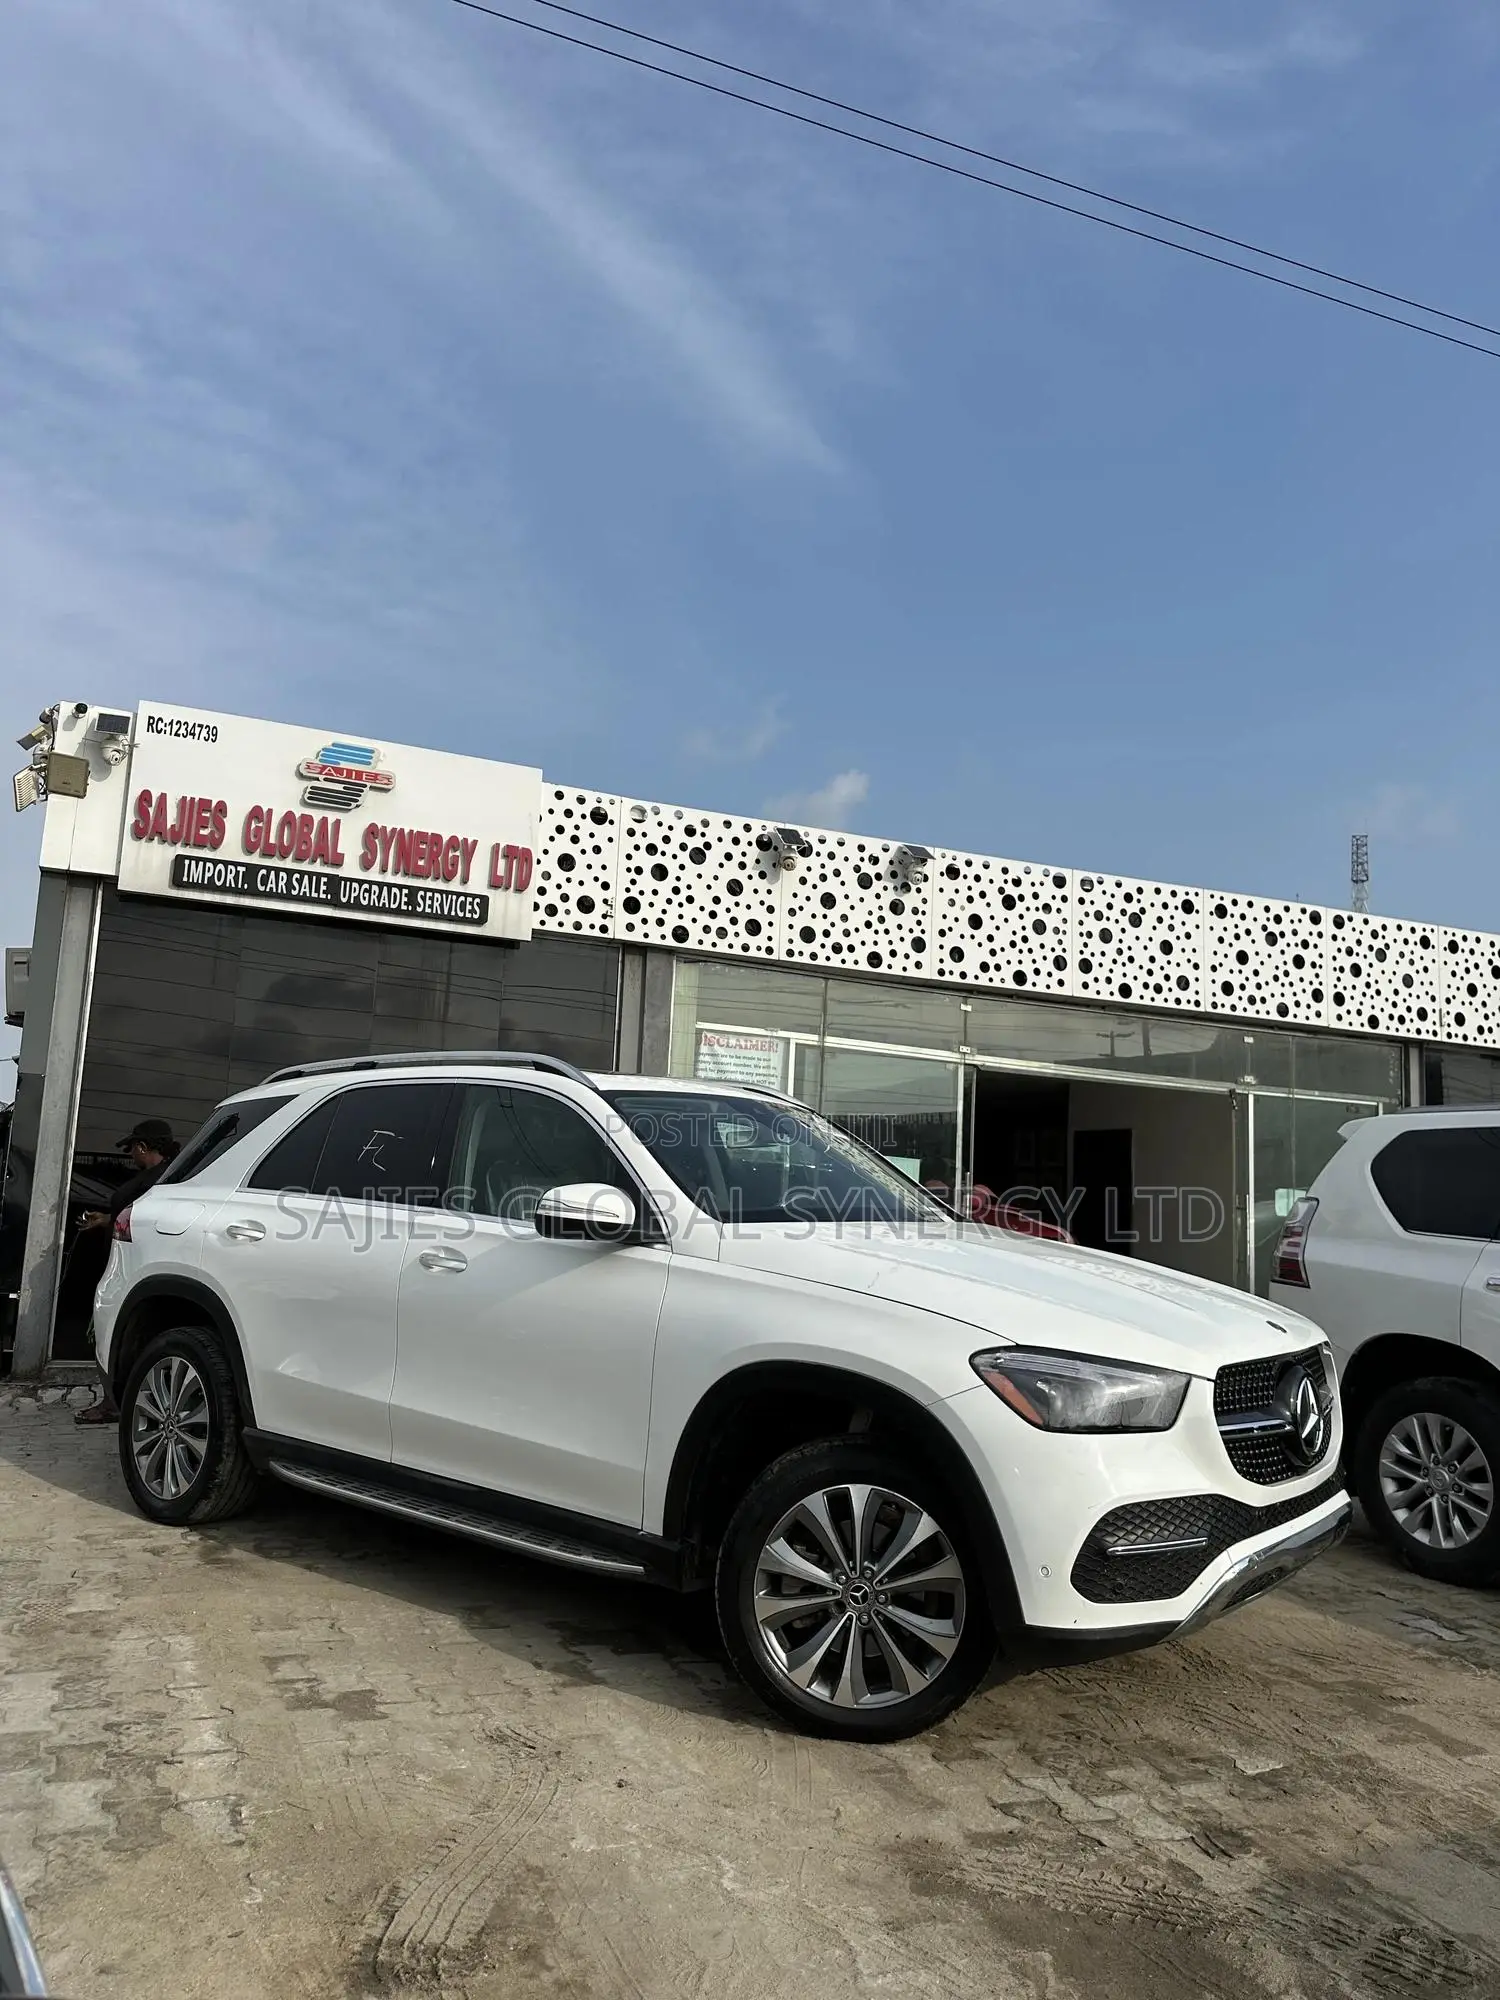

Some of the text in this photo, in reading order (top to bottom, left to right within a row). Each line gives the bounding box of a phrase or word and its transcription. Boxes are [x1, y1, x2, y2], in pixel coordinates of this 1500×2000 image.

[146, 715, 218, 743] RC:1234739
[306, 761, 394, 785] SAJIES
[131, 788, 533, 892] SAJIES GLOBAL SYNERGY LTD
[182, 859, 481, 920] IMPORT. CAR SALE. UPGRADE. SERVICES
